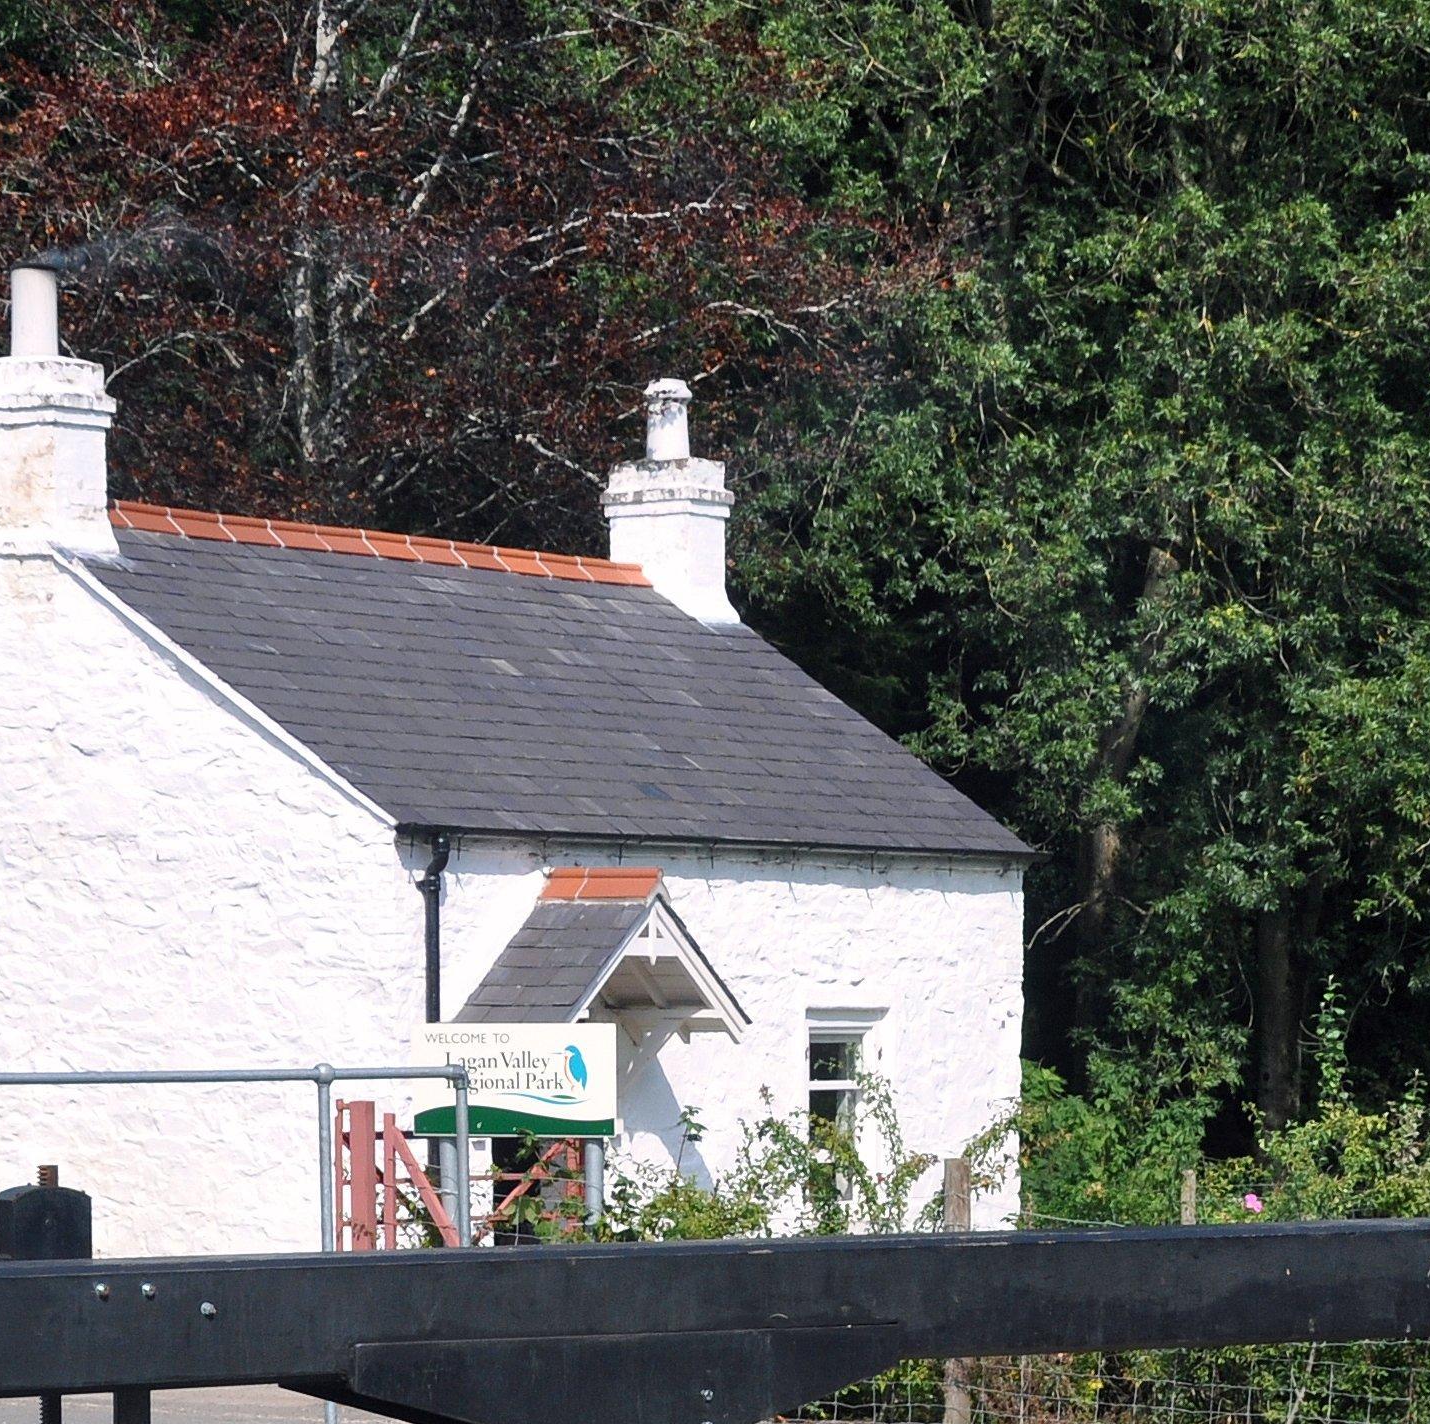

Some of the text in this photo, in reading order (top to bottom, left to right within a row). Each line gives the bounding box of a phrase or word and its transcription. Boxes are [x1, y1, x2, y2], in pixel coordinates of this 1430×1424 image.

[425, 1033, 510, 1044] WELCOME TO
[500, 1050, 550, 1074] Valley
[526, 1072, 564, 1090] Park
